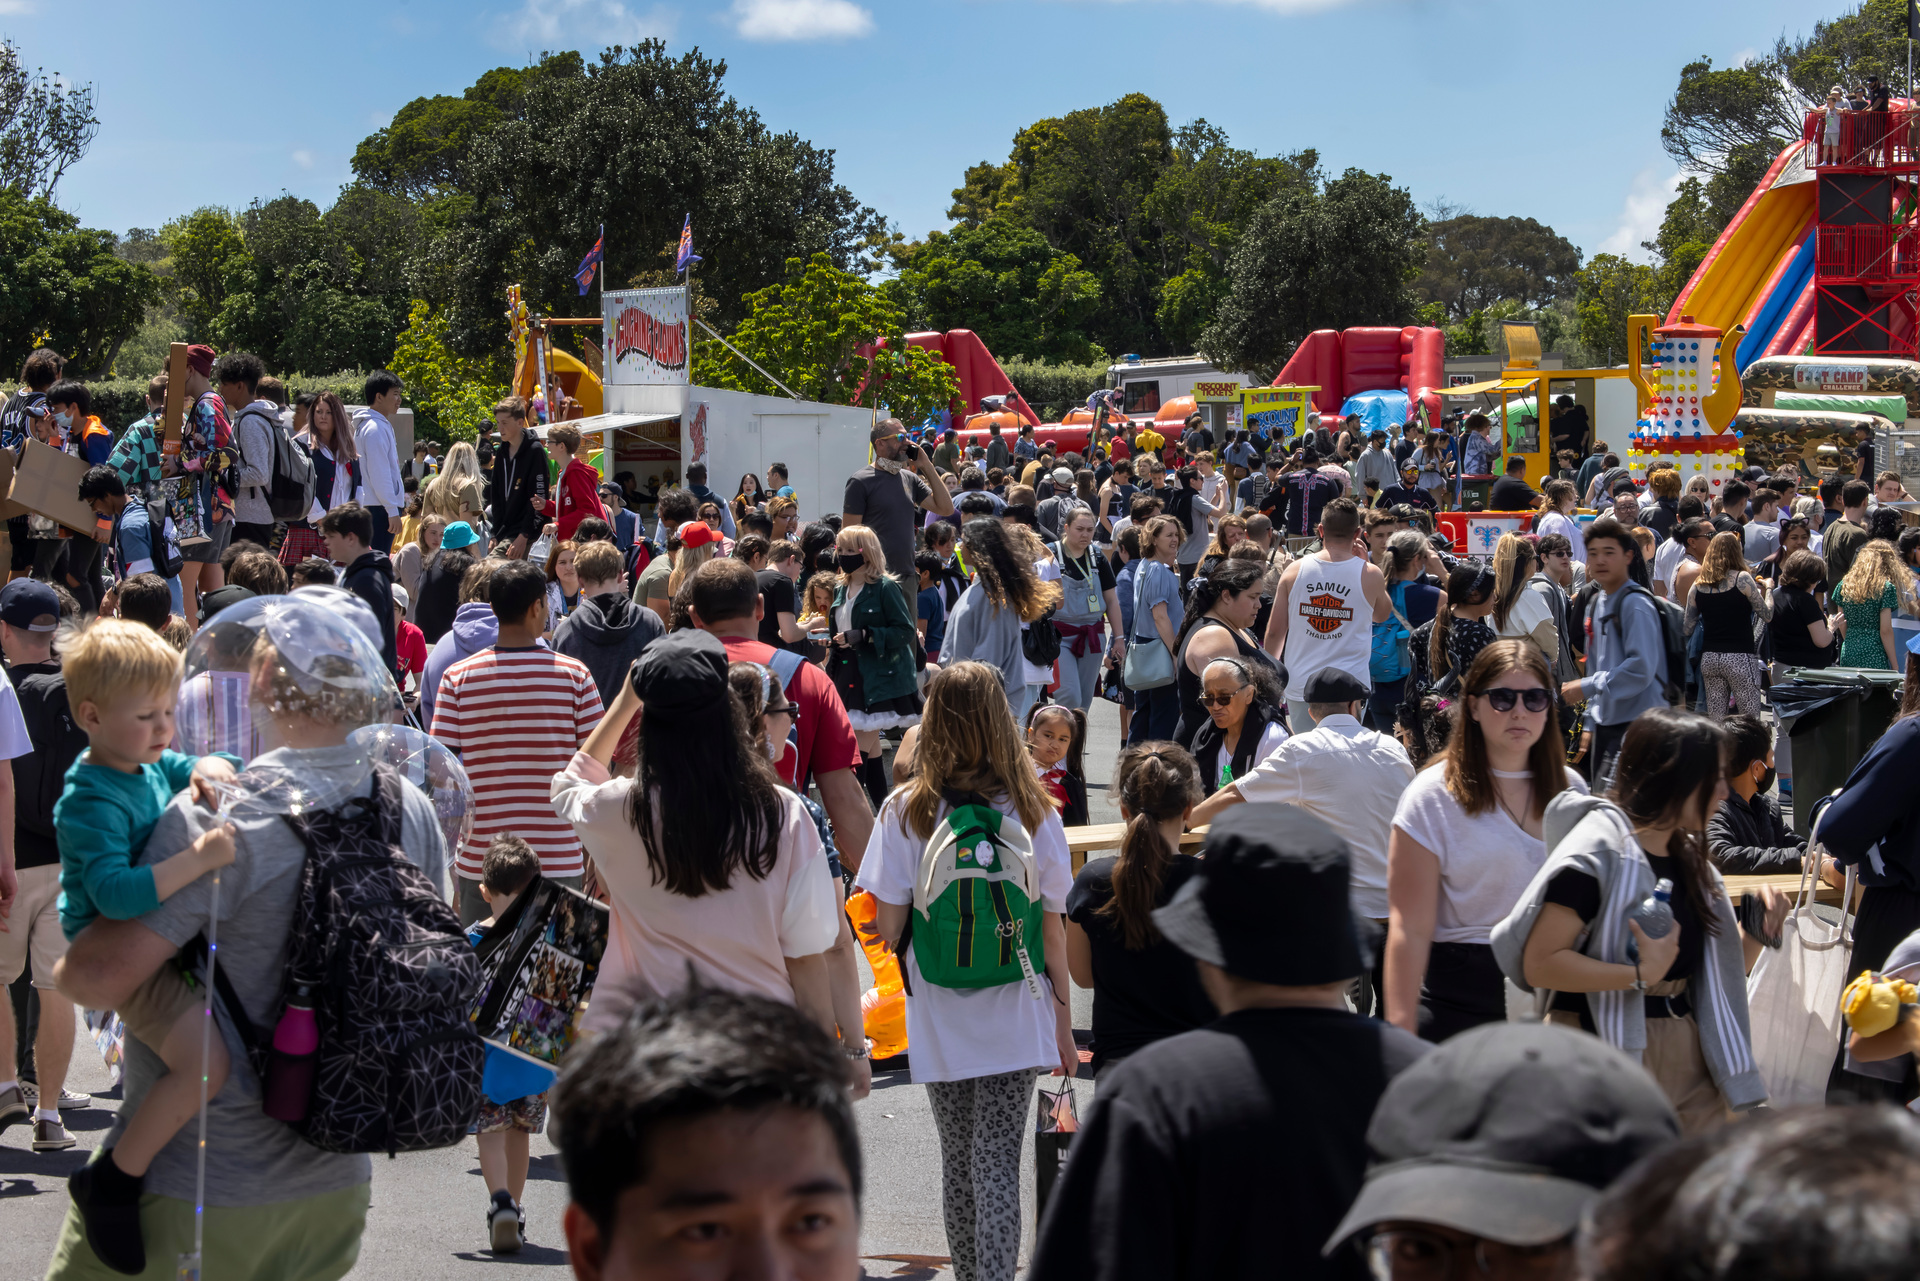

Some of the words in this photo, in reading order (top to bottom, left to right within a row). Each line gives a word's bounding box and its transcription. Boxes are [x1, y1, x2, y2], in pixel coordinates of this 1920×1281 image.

[615, 306, 654, 359] LAUGHING
[653, 318, 685, 367] CLOWNS
[1834, 370, 1863, 383] CAMP
[1197, 382, 1238, 391] DISCOUNT
[1201, 388, 1234, 397] TICKETS
[1306, 582, 1351, 597] SAMUI
[1312, 595, 1341, 608] MOTOR
[1301, 604, 1351, 619] HARLEY-DAVIDSON
[1310, 617, 1339, 632] CYCLES
[1305, 628, 1343, 640] THAILAND
[496, 986, 525, 1030] KISS
